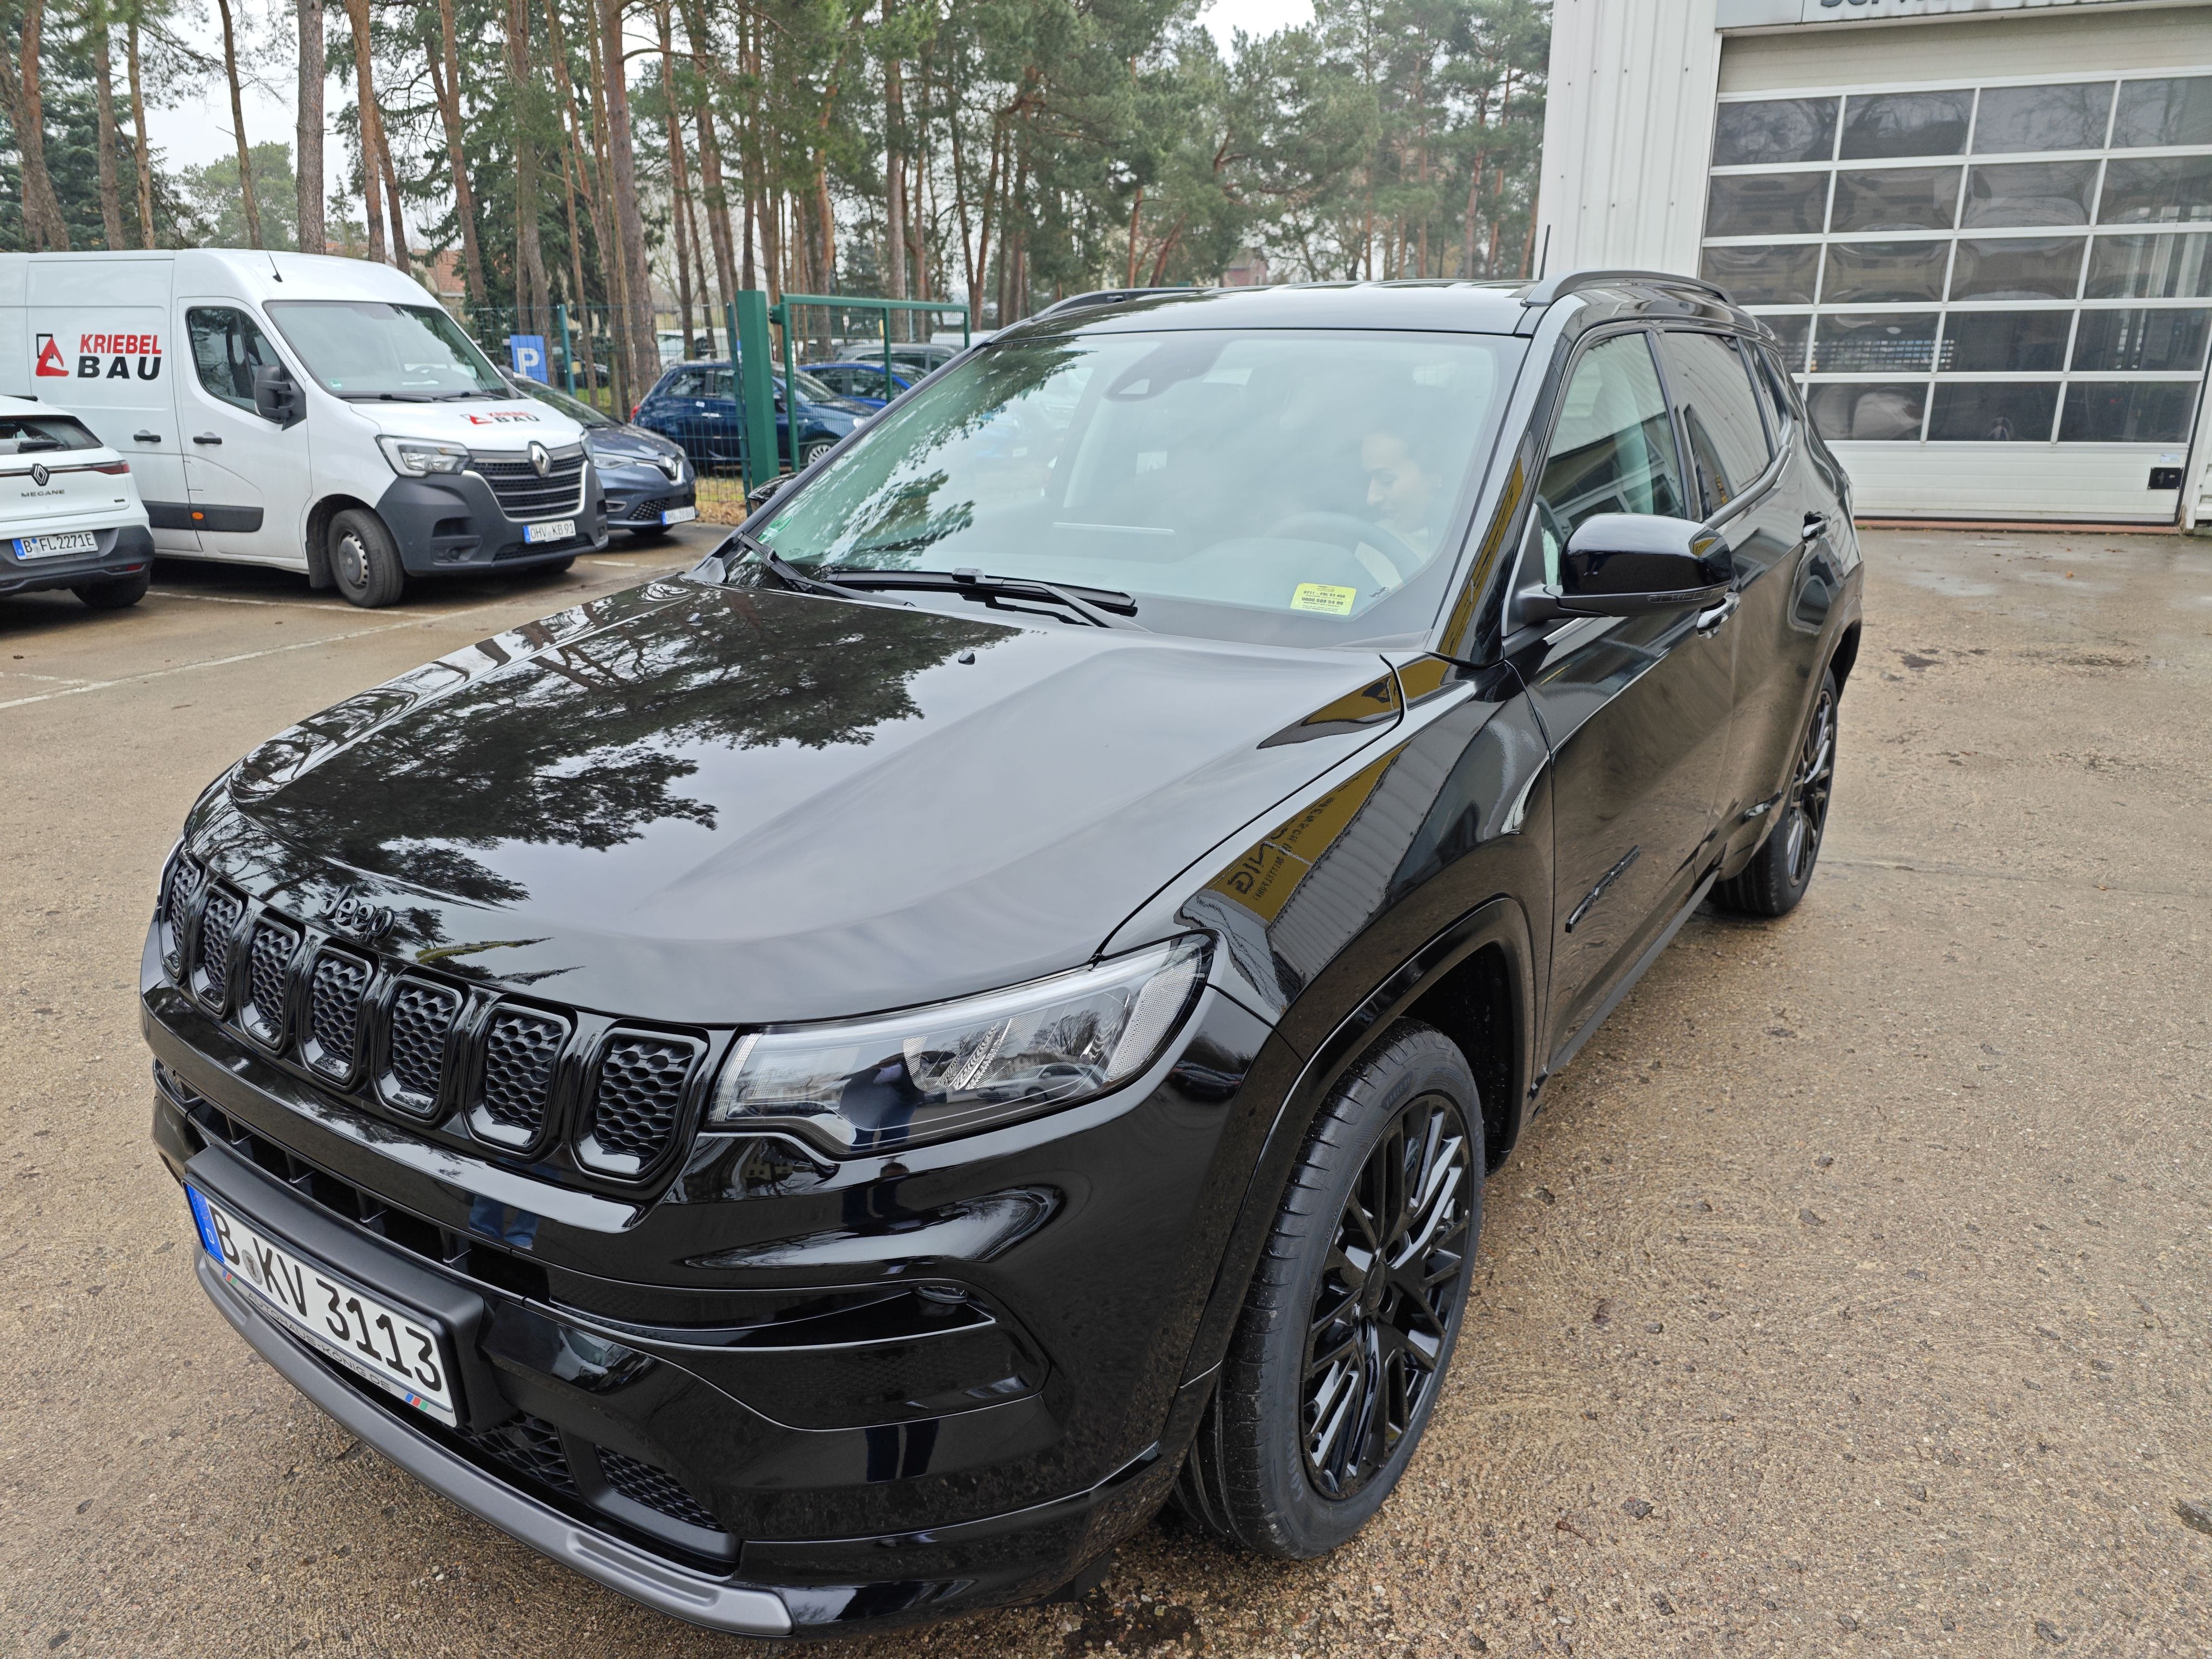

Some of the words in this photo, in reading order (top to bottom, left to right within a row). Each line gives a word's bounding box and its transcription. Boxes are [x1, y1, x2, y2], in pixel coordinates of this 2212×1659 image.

[79, 334, 162, 354] KRIEBEL
[77, 355, 161, 380] BAU
[517, 347, 539, 375] P
[21, 489, 65, 497] MEGANE
[23, 539, 32, 553] B
[39, 537, 57, 551] FL
[56, 533, 94, 549] 2271E
[531, 526, 546, 538] OHV
[552, 524, 563, 536] KB
[564, 523, 574, 534] 91
[319, 885, 395, 944] Jeep
[205, 1228, 214, 1244] D
[208, 1203, 240, 1266] B
[253, 1237, 307, 1317] KV
[316, 1278, 442, 1392] 3113
